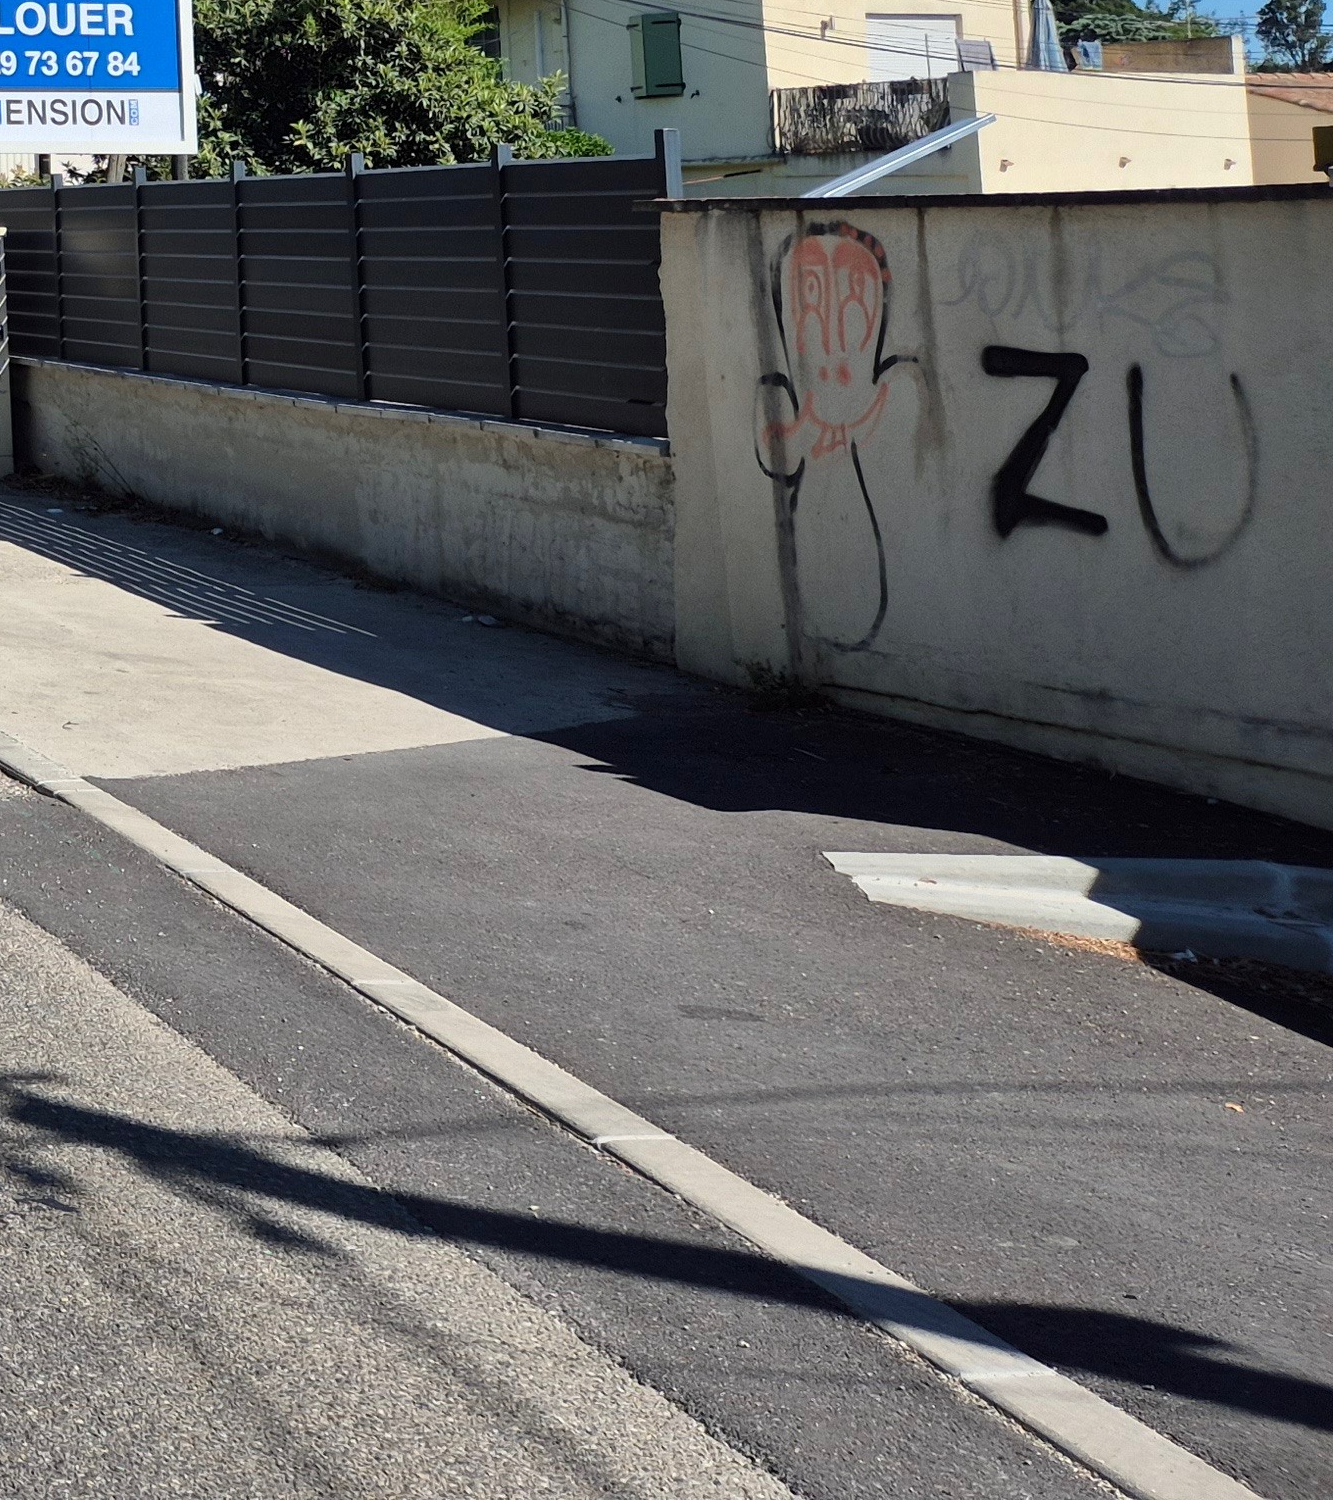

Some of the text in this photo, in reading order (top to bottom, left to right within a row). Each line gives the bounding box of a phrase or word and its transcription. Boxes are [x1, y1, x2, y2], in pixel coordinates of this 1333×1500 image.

[24, 50, 59, 76] 73
[65, 51, 100, 76] 67
[107, 51, 141, 77] 84
